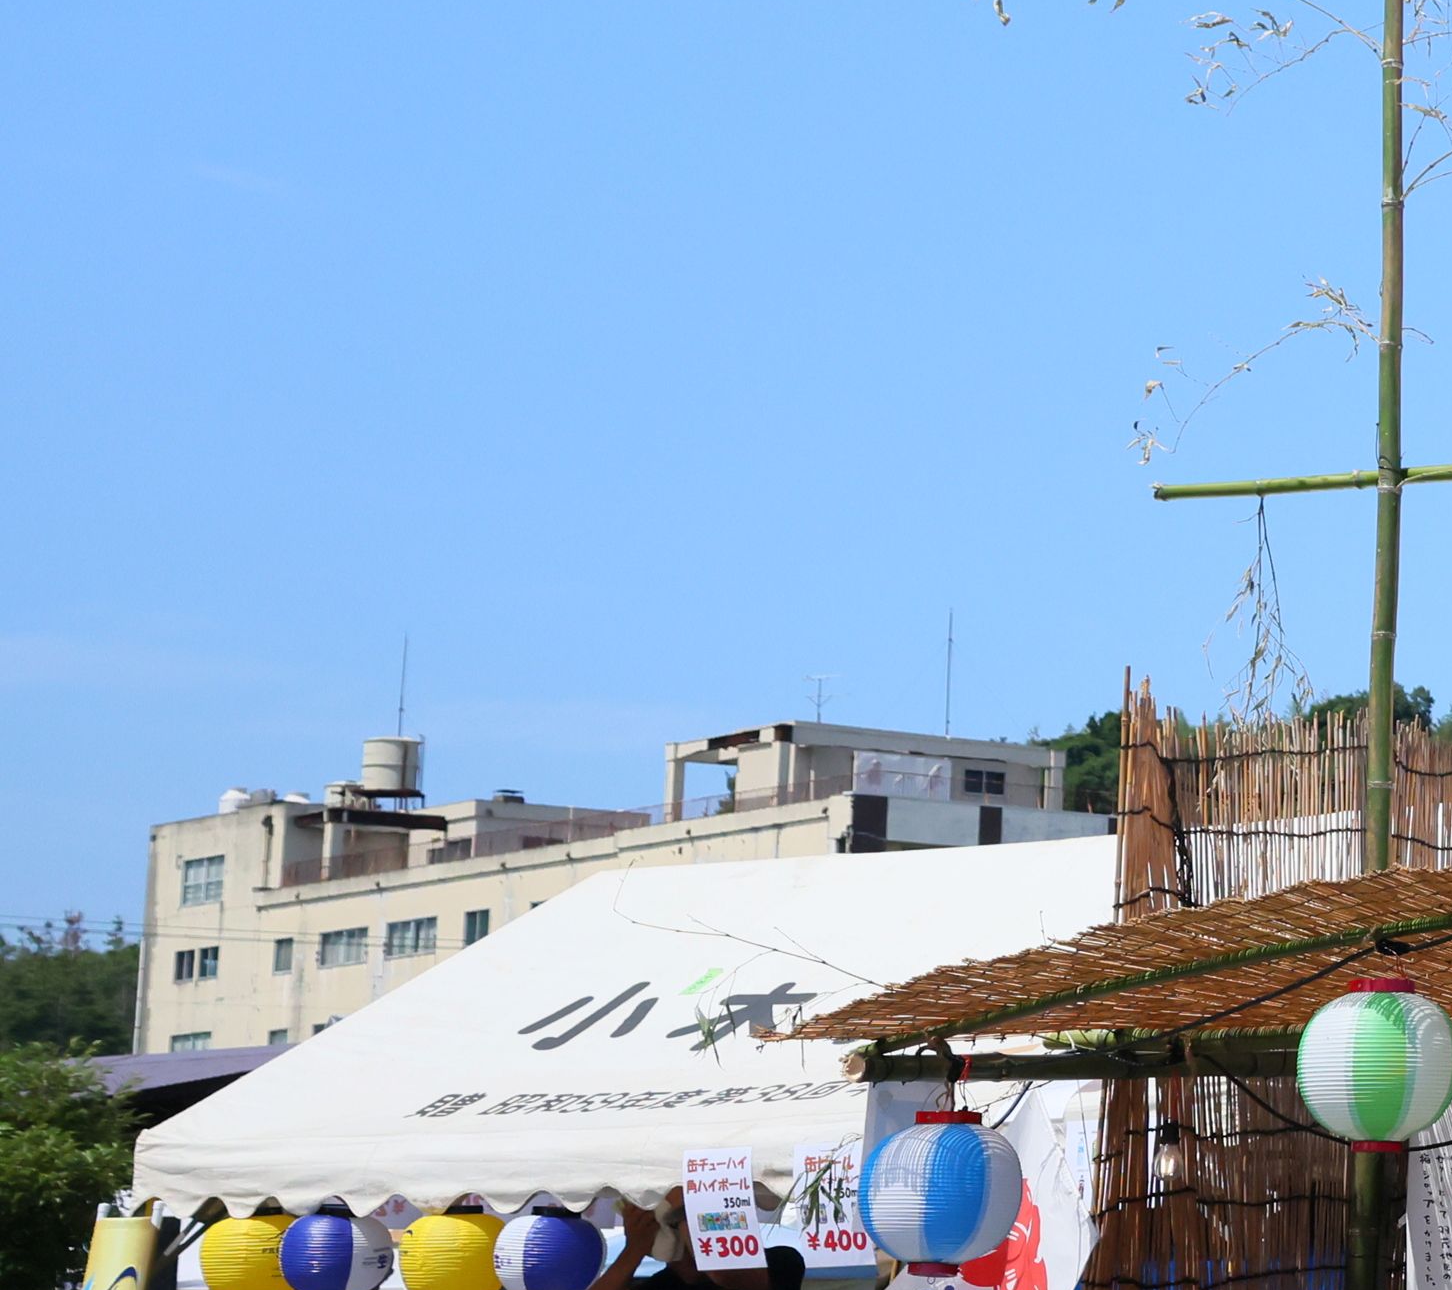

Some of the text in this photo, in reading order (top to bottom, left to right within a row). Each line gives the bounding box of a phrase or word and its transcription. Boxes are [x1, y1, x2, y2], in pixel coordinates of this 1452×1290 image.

[687, 1157, 747, 1172] 缶チューハイ
[686, 1178, 750, 1194] 角ハイボール
[724, 1196, 751, 1209] 350ml
[698, 1234, 760, 1258] ¥300
[806, 1229, 868, 1252] ¥400
